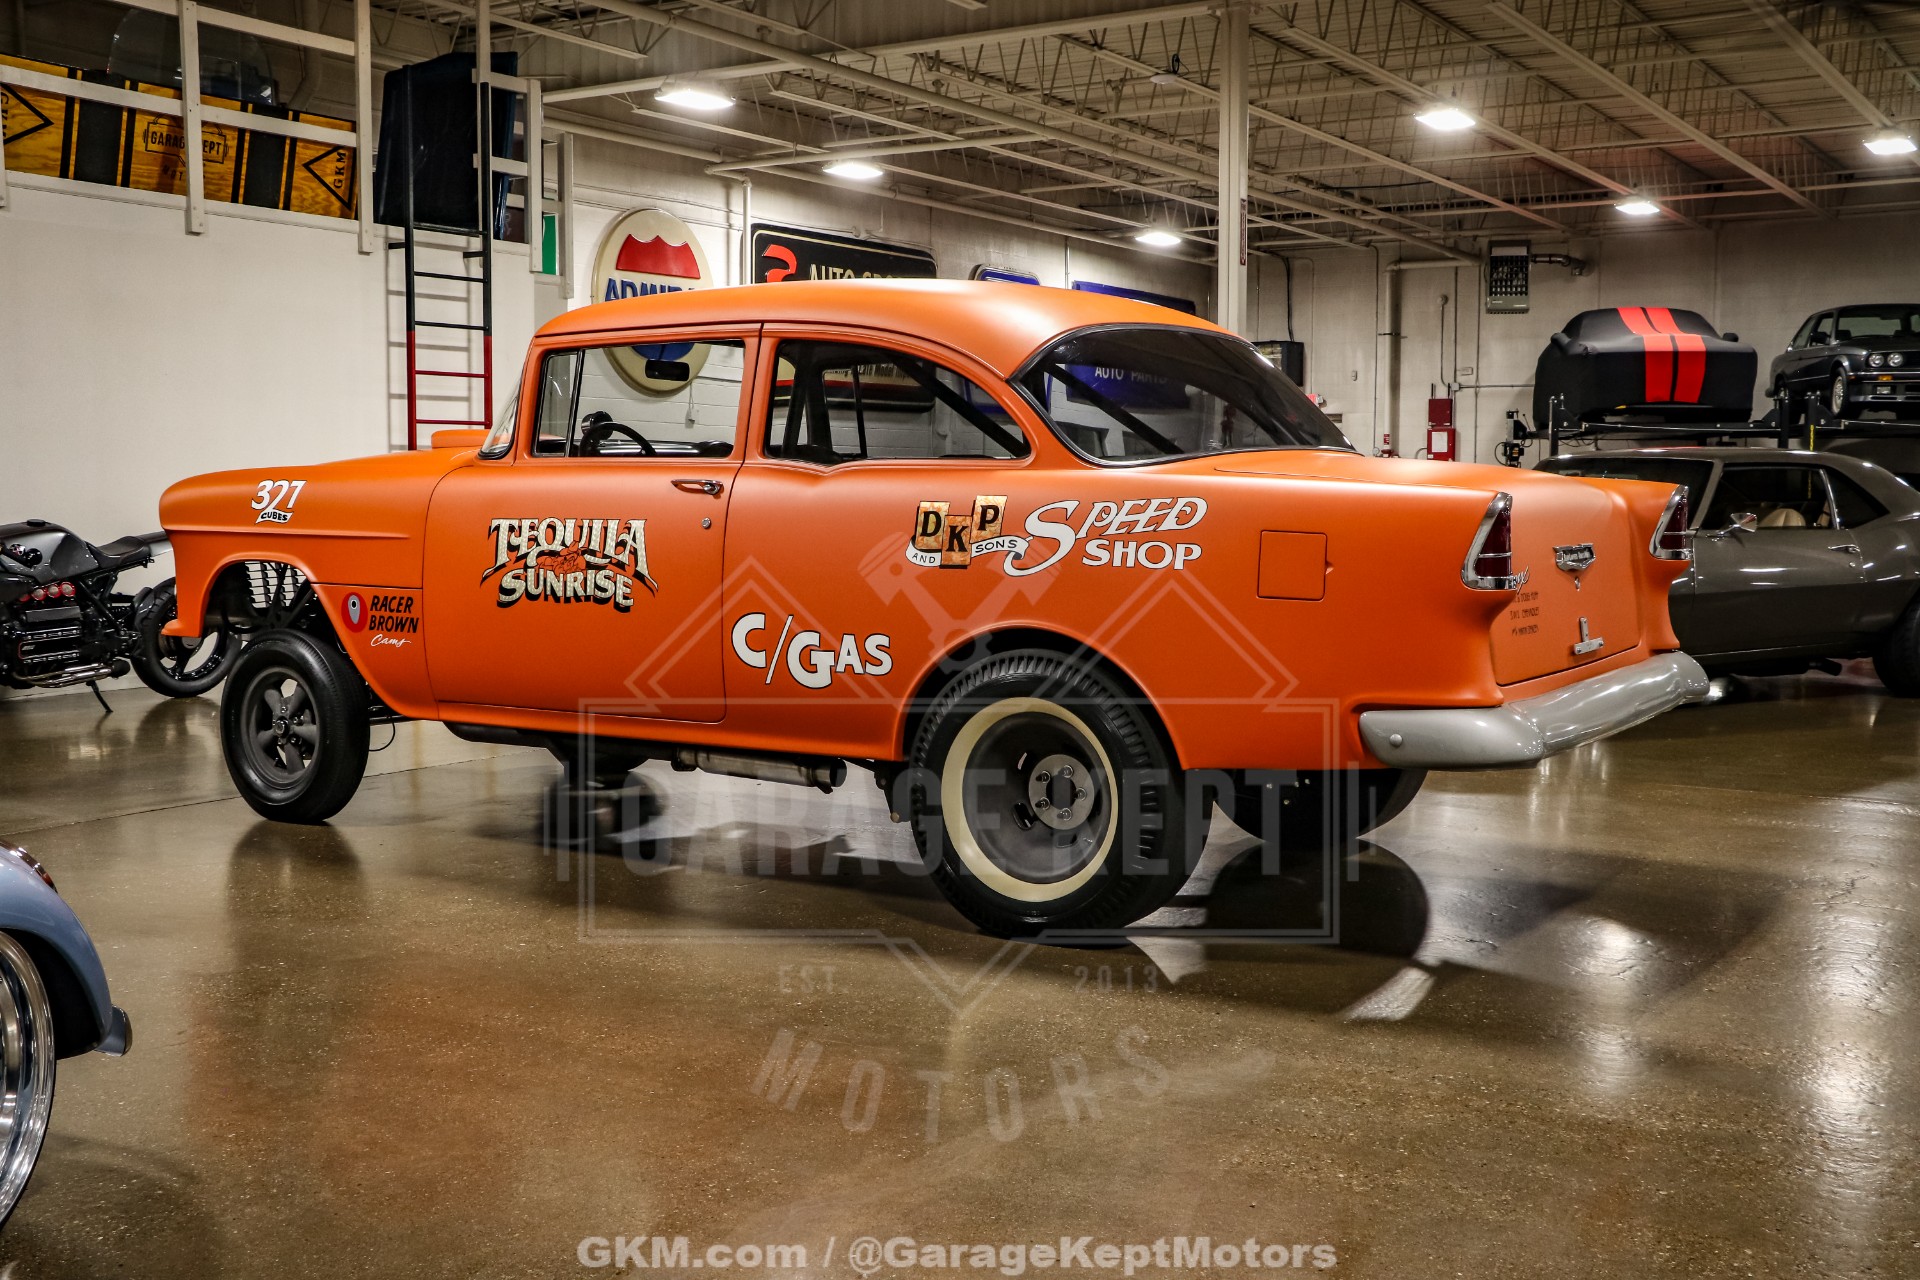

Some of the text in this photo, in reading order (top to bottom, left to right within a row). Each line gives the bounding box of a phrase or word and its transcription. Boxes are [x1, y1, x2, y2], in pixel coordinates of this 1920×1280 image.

[202, 140, 222, 156] EPT
[333, 150, 347, 189] GKM
[1094, 366, 1124, 380] AUTO
[251, 479, 307, 512] 327
[260, 510, 288, 522] CUBES
[1003, 496, 1209, 577] SPEED
[480, 516, 659, 596] TEQUILA
[911, 538, 1019, 565] AND SONS
[1081, 538, 1202, 571] SHOP
[497, 567, 634, 613] SUNRISE
[369, 595, 414, 614] RACER
[368, 615, 419, 633] BROWN
[370, 633, 412, 648] Cams
